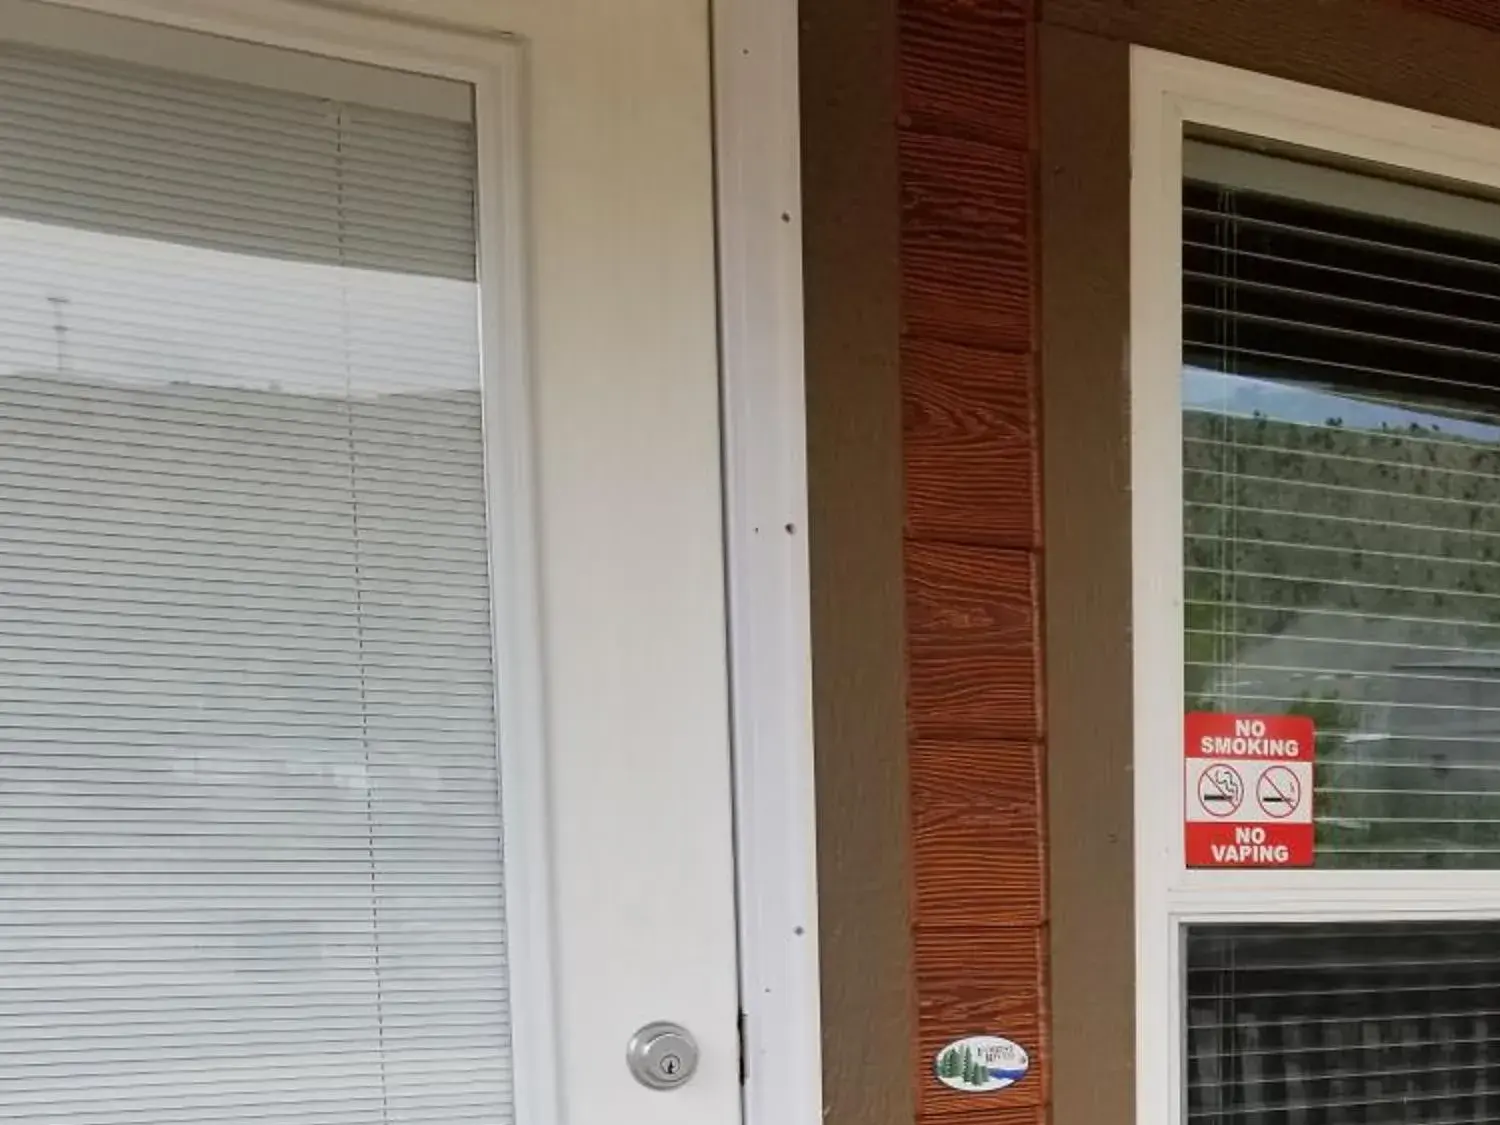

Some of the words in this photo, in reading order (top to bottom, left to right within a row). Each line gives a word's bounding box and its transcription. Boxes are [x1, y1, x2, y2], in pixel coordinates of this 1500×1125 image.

[1235, 719, 1266, 737] NO
[1201, 736, 1299, 757] SMOKING
[1235, 827, 1266, 845] NO
[1210, 844, 1289, 862] VAPING
